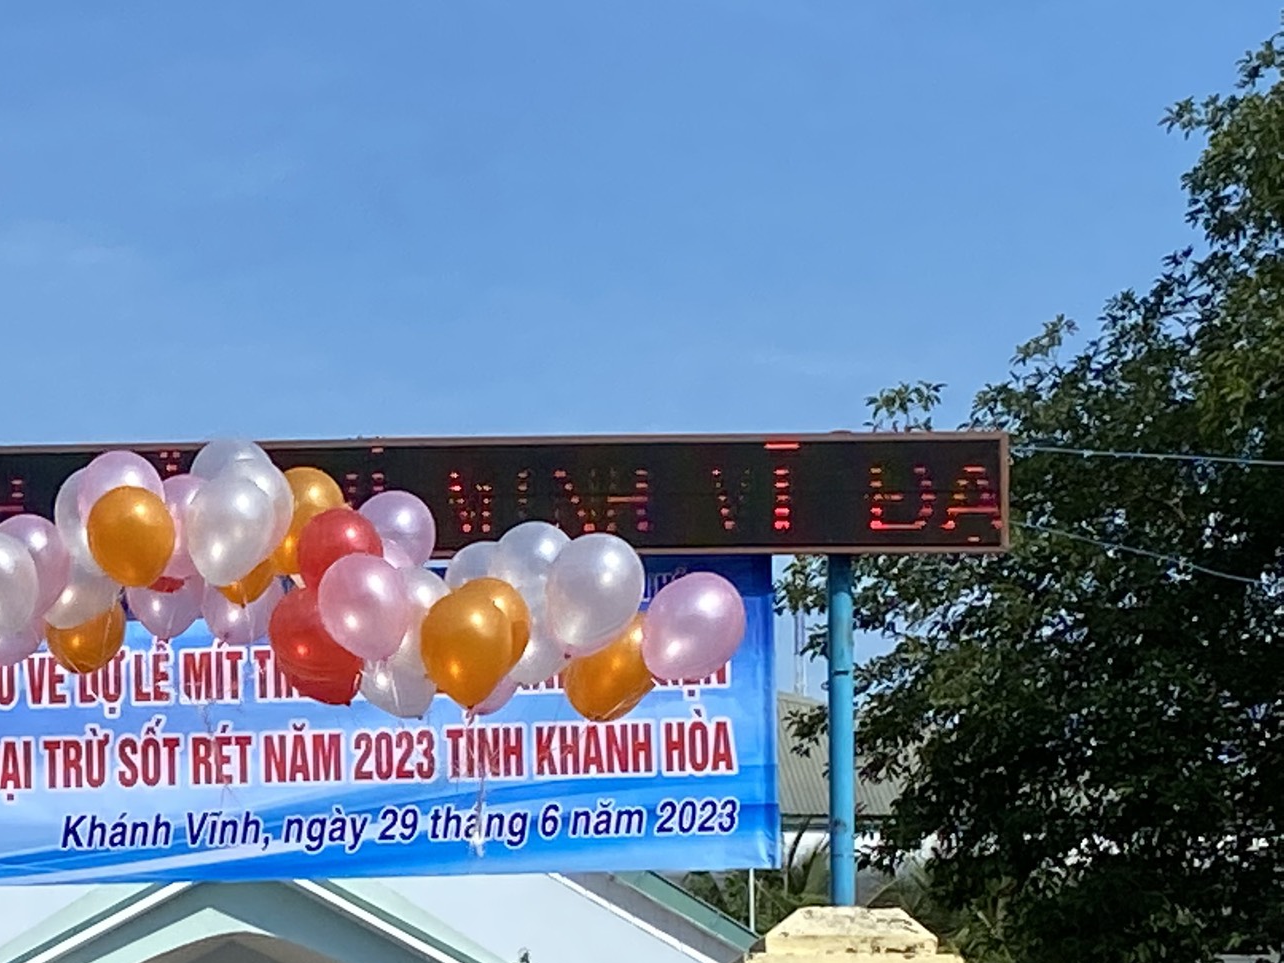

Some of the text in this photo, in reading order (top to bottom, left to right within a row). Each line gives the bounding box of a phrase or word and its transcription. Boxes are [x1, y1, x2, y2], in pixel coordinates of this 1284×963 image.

[183, 640, 243, 700] MÍT
[43, 728, 109, 788] TRỪ
[118, 719, 180, 787] SỐT
[191, 724, 252, 785] RÉT
[264, 723, 343, 782] NĂM
[354, 730, 436, 781] 2023
[665, 709, 734, 772] HÒA
[61, 800, 737, 852] Khánh Vĩnh, ngày 29 tháng 6 năm 2023
